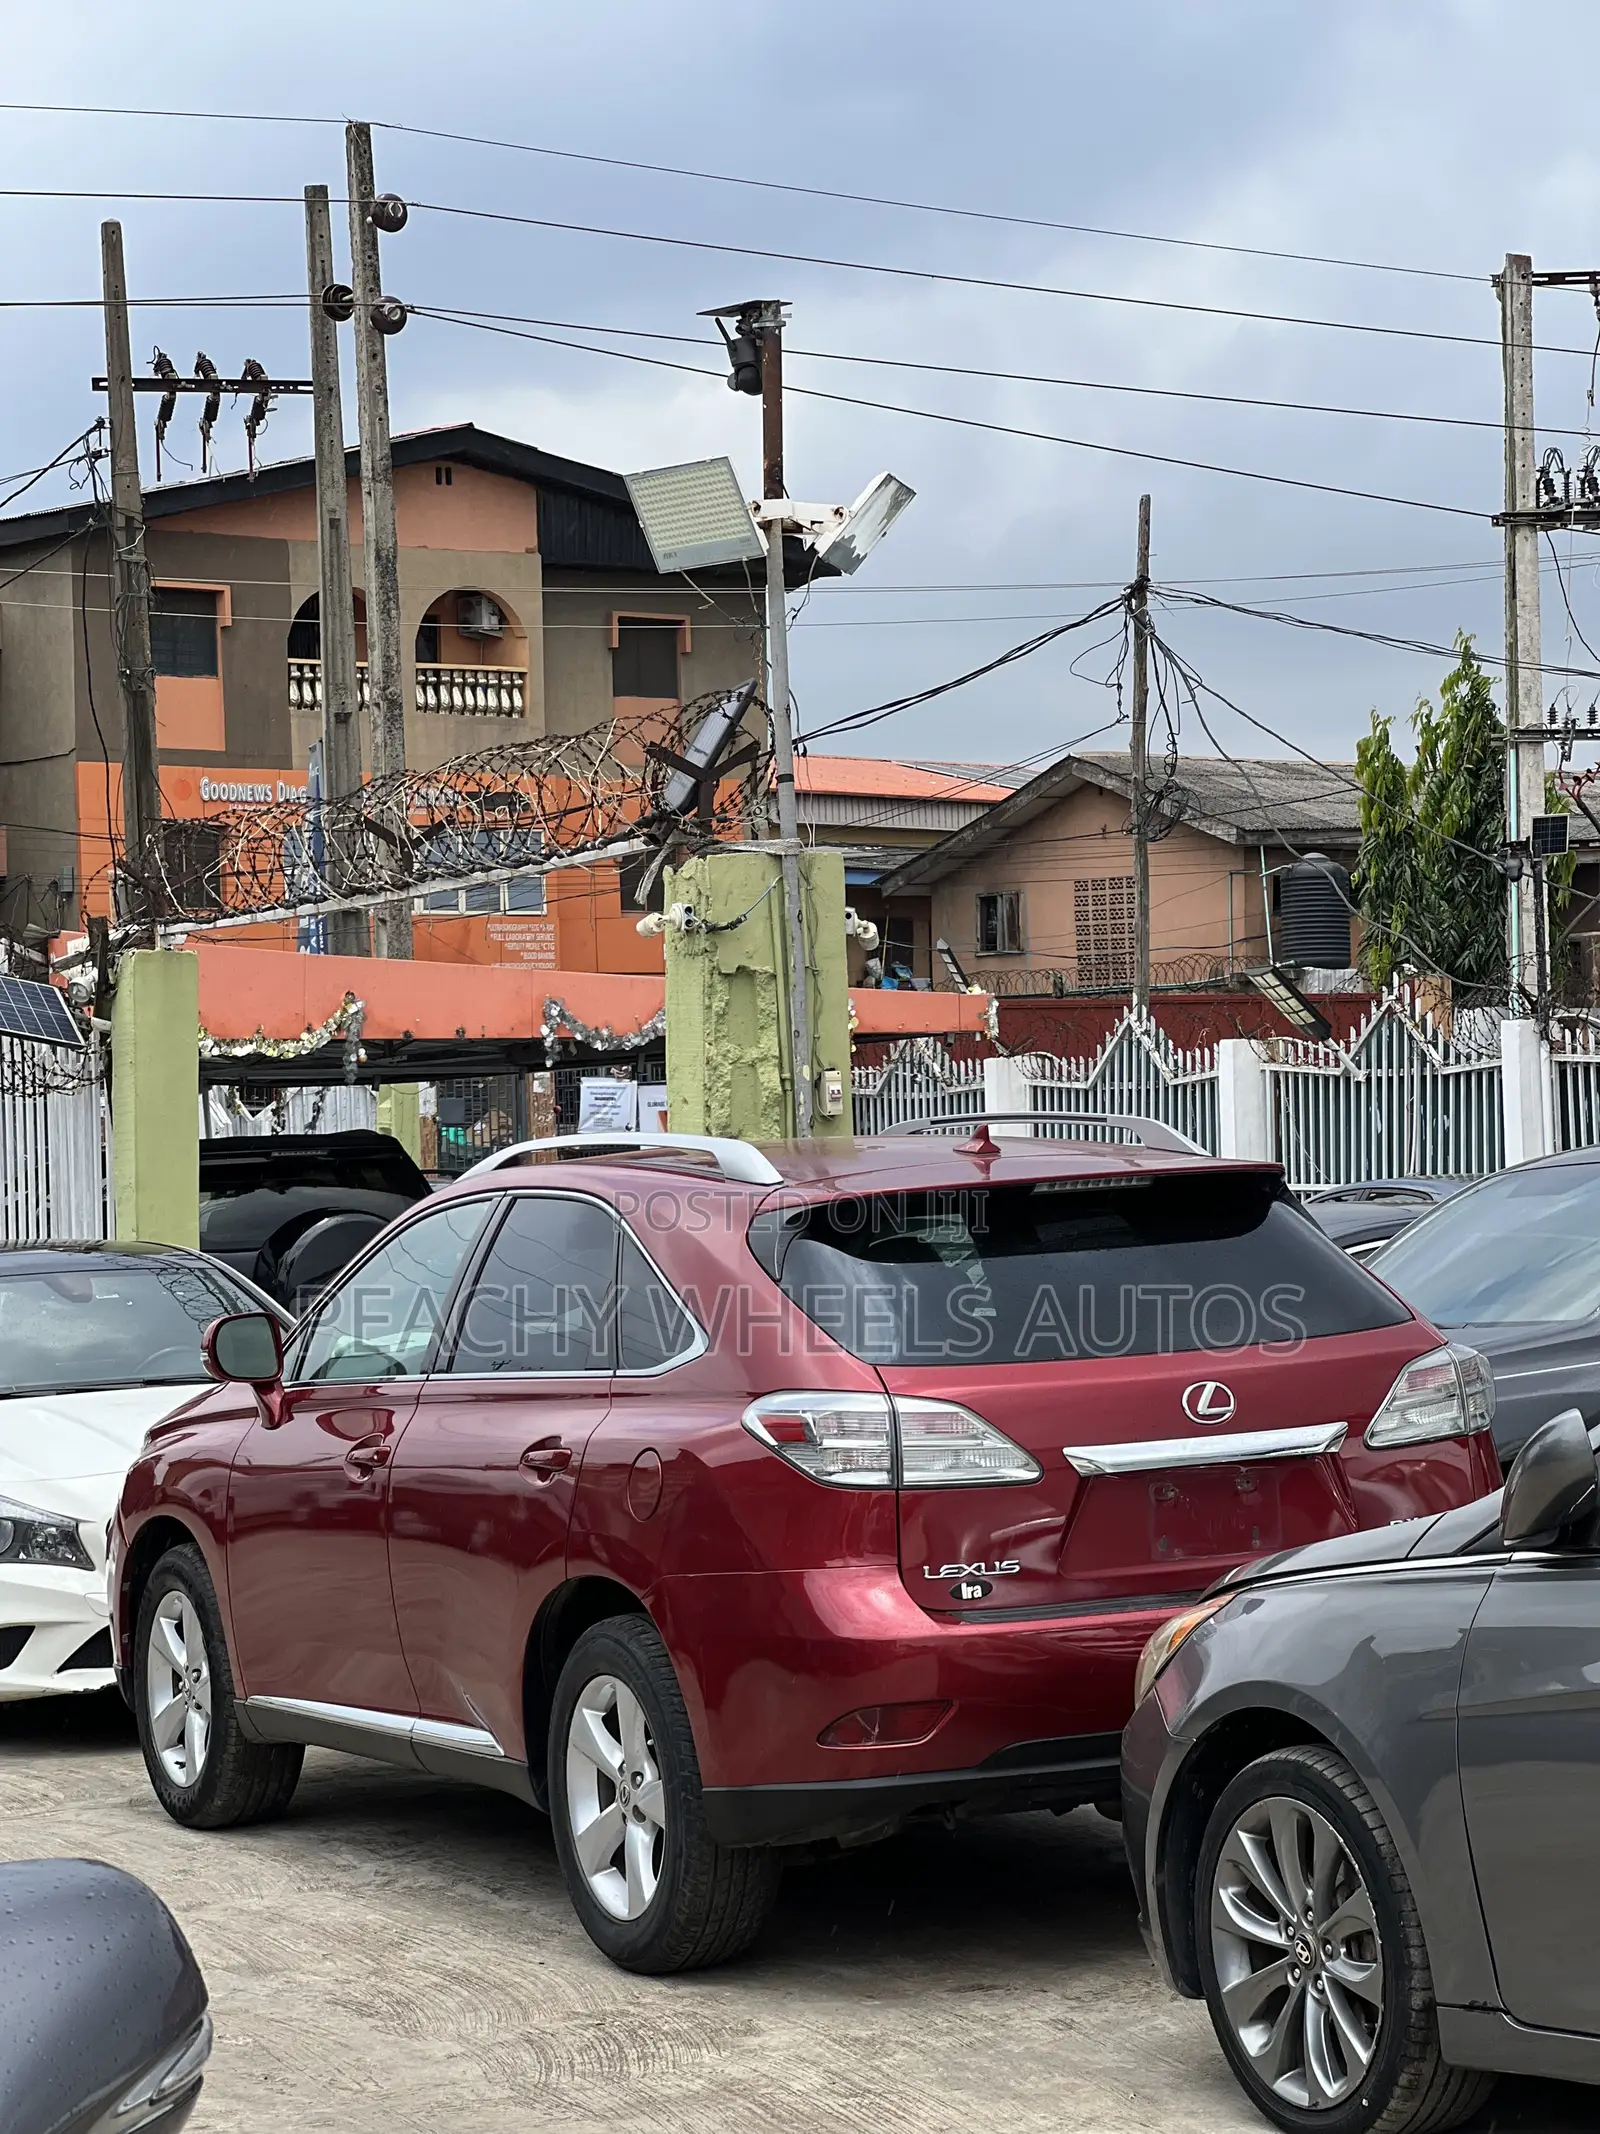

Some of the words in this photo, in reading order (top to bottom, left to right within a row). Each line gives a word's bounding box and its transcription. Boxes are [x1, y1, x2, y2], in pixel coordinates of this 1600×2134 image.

[201, 776, 272, 802] GOODNEWS
[535, 933, 555, 941] SERVICE
[923, 1560, 1020, 1578] LEXUS
